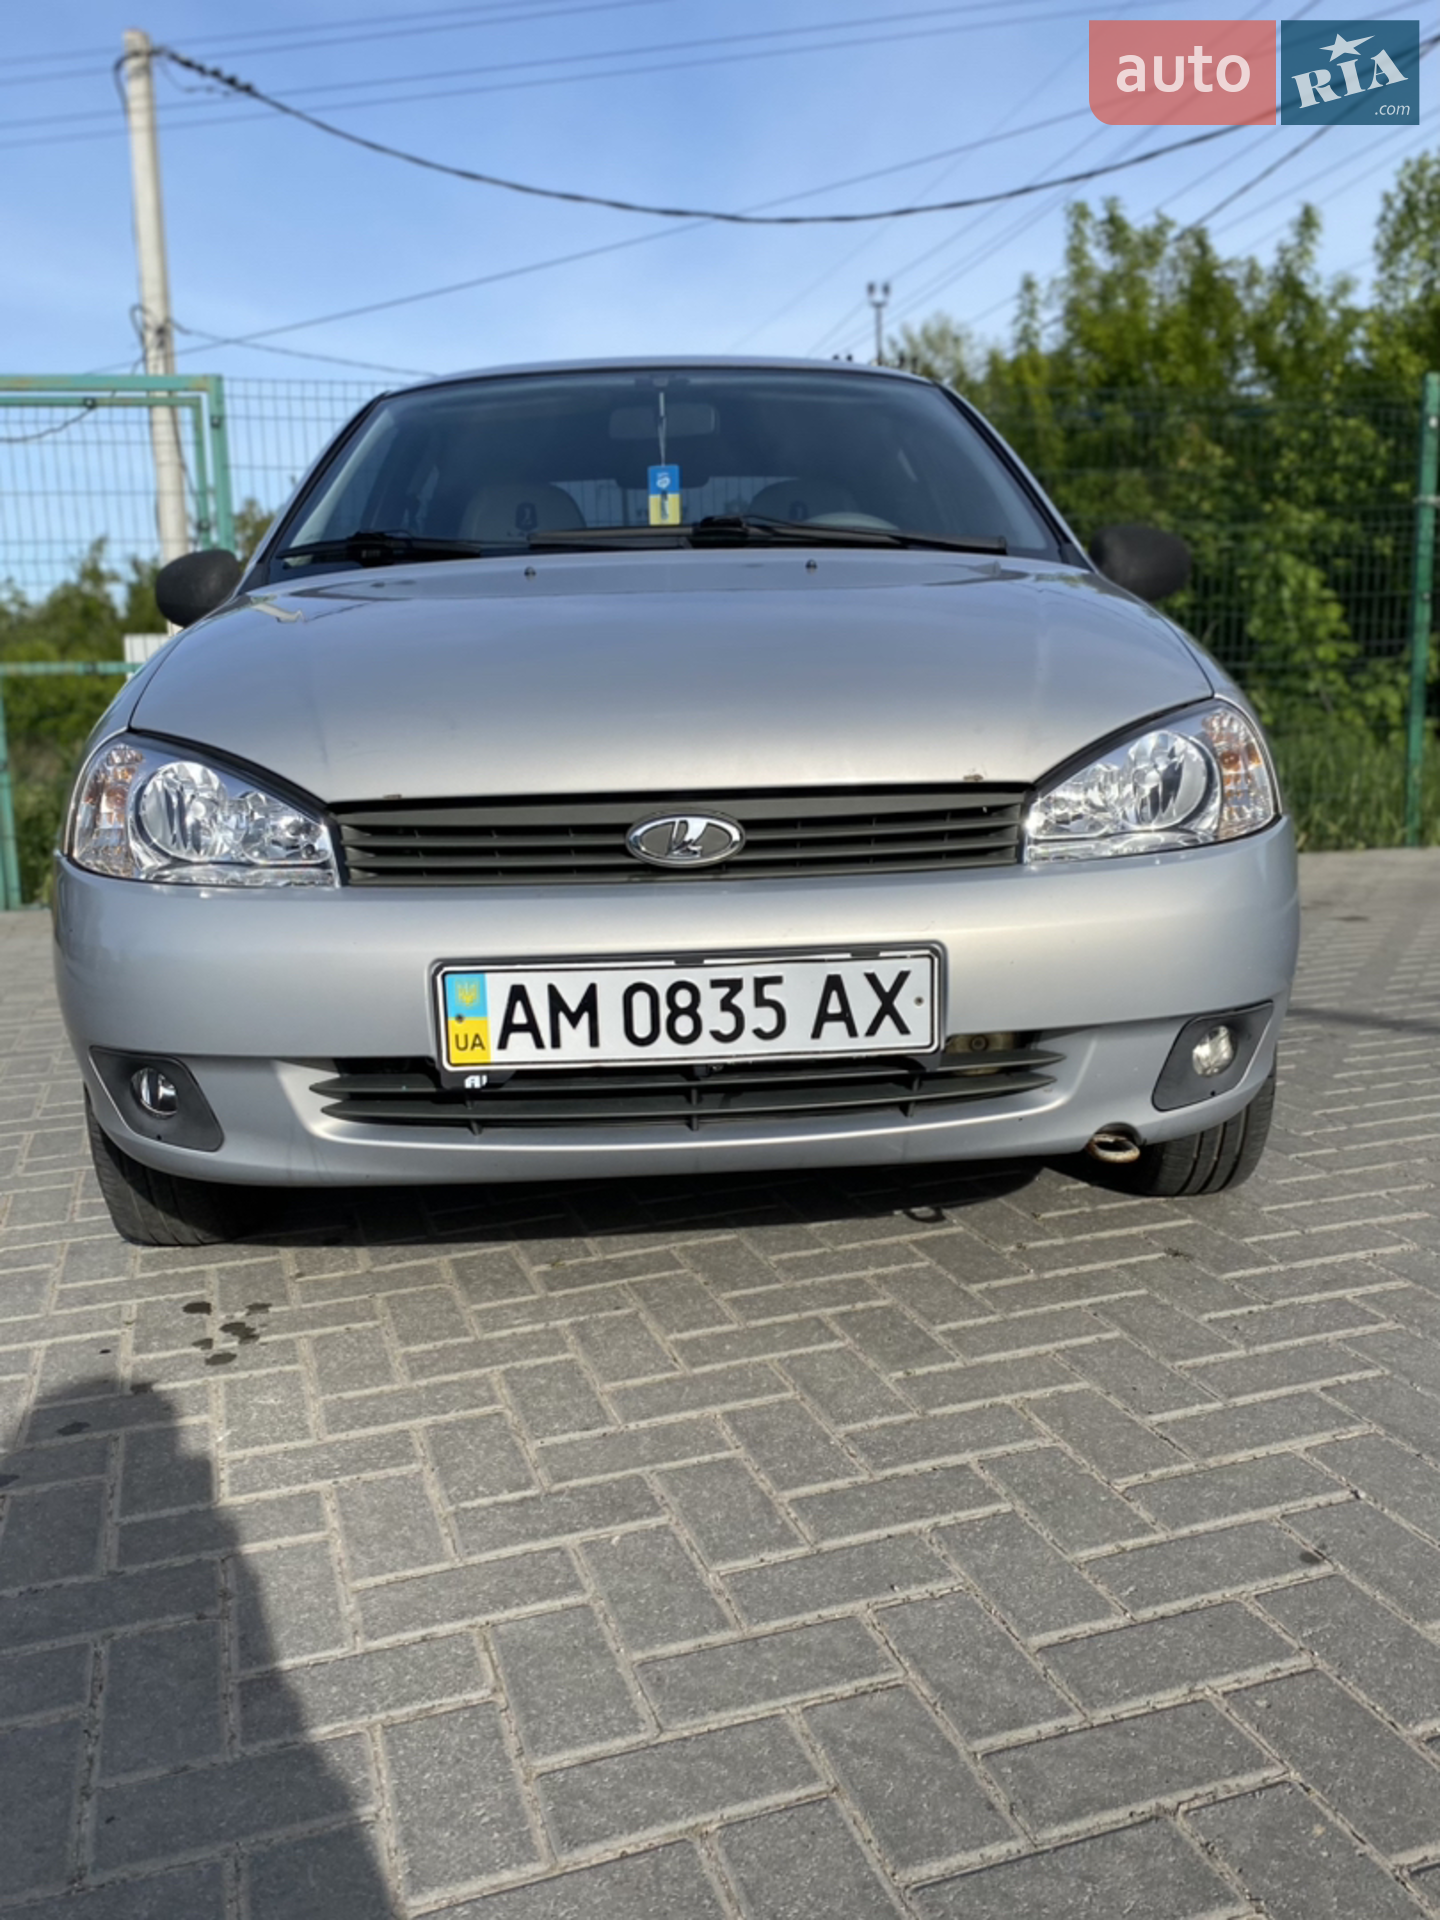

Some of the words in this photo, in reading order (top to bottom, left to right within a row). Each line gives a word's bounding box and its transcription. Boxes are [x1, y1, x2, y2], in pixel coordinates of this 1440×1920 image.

[497, 982, 601, 1051] AM
[621, 975, 788, 1048] 0835
[810, 969, 913, 1040] AX
[454, 1032, 487, 1052] UA
